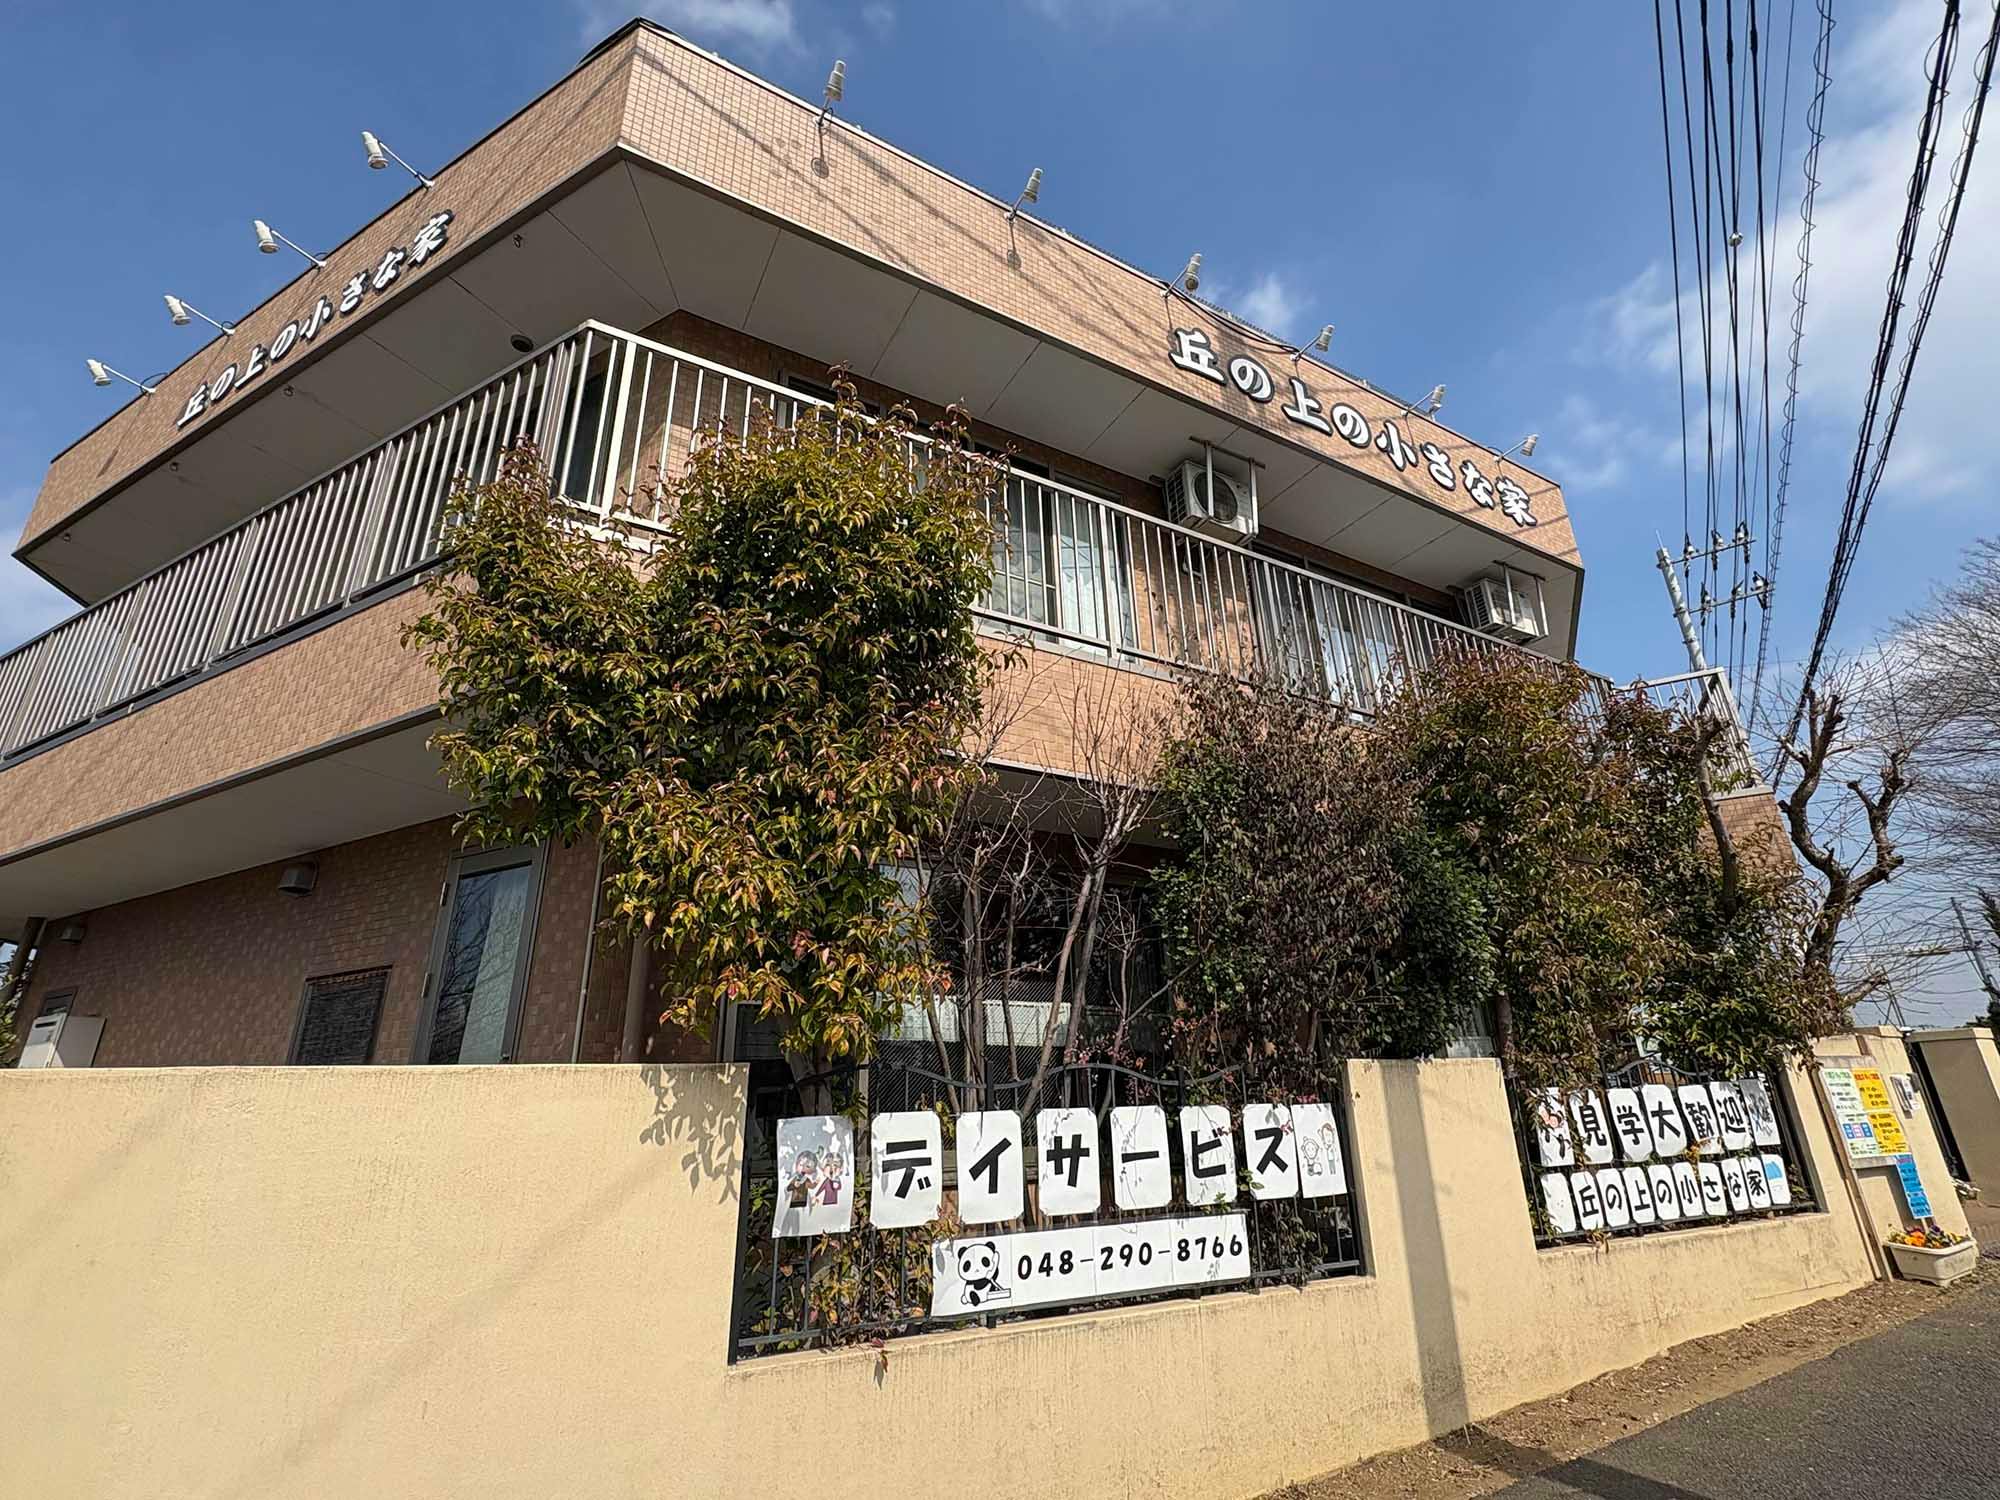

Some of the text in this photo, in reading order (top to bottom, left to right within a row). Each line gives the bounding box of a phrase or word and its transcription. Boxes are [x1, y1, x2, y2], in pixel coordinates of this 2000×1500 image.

[177, 209, 455, 429] 丘の上の小さな家
[1168, 327, 1537, 527] 丘の上の小さな家
[1577, 1095, 1746, 1147] 見学大歓迎
[881, 1127, 1288, 1200] デイサービス
[1578, 1169, 1765, 1218] 丘の上の小さな家
[1017, 1234, 1243, 1280] 048-290-8766
